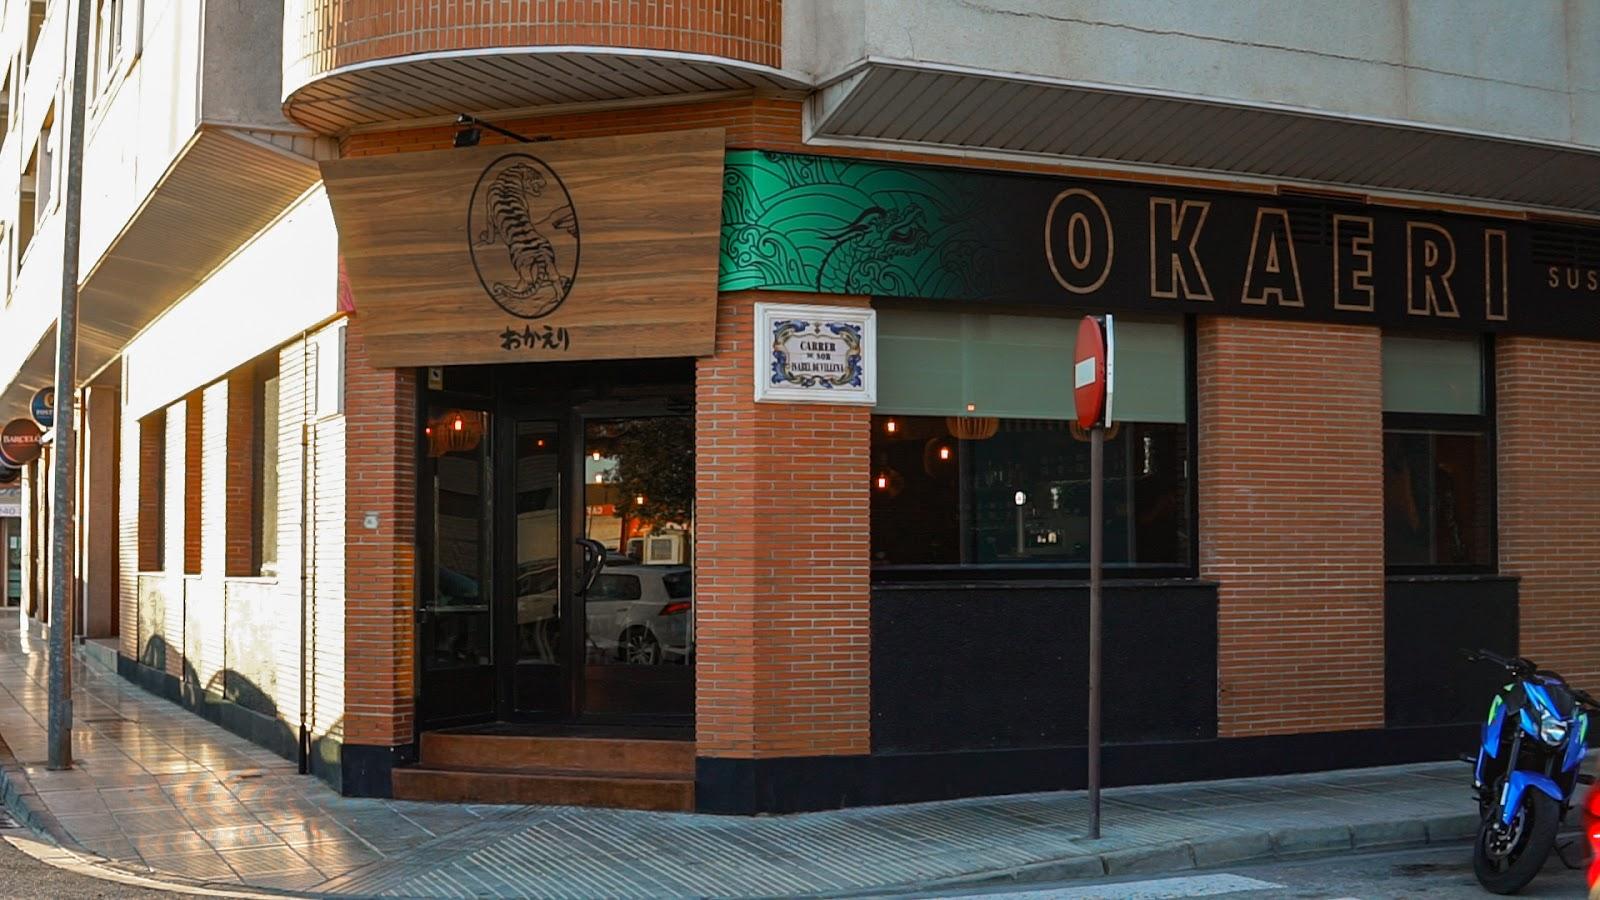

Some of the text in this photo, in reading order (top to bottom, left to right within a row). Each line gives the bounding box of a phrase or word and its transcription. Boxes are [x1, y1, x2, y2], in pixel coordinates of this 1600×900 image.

[1044, 188, 1508, 321] OKAERI
[499, 324, 570, 351] おかえり
[800, 341, 836, 352] CARRER
[816, 353, 831, 361] SOR
[791, 362, 844, 373] ISABEL DE VILLENA
